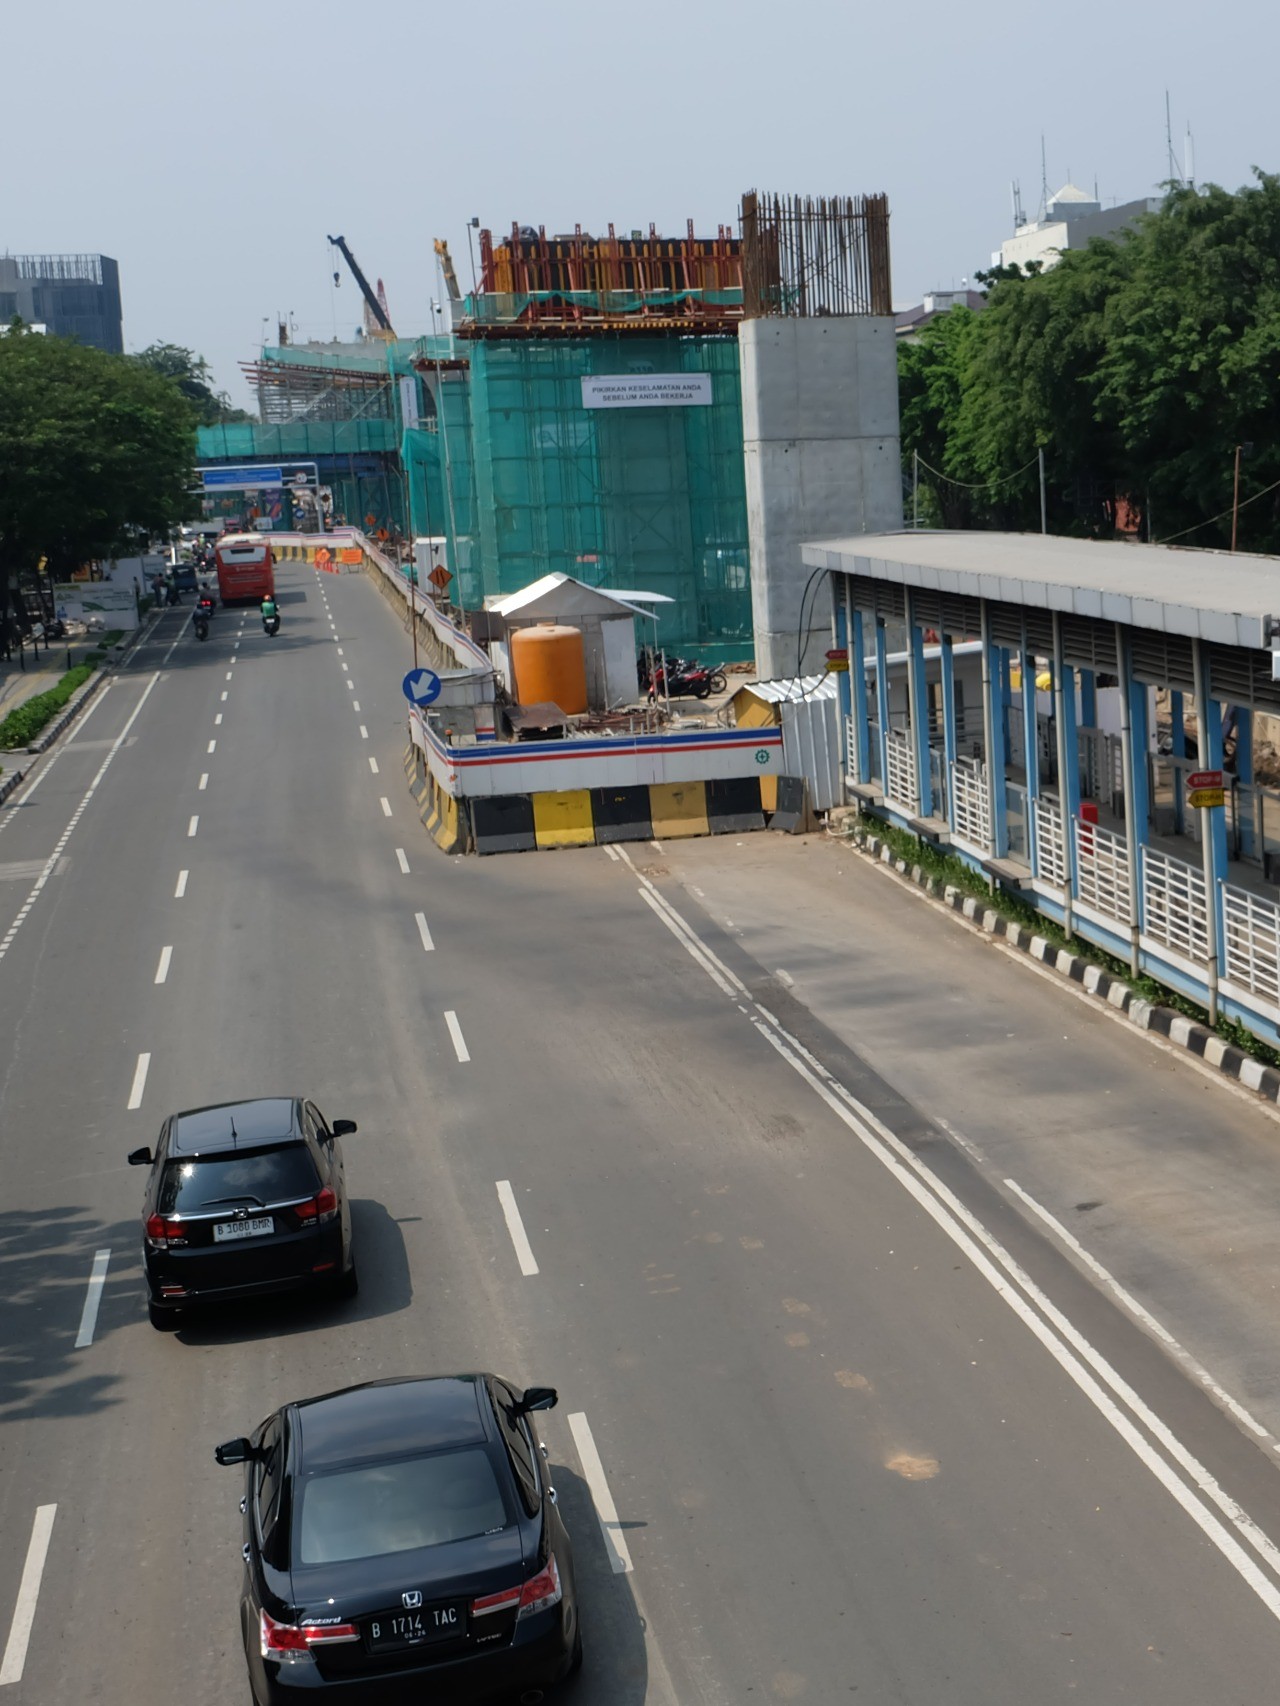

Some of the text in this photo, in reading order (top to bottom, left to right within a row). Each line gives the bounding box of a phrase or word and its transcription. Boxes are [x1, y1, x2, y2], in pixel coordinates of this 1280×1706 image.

[592, 386, 627, 394] PIKIRKAN
[628, 384, 680, 393] KESELAMATAN
[602, 394, 637, 402] SEBELUM
[217, 1225, 224, 1236] B
[372, 1608, 457, 1639] B 1714 TAC
